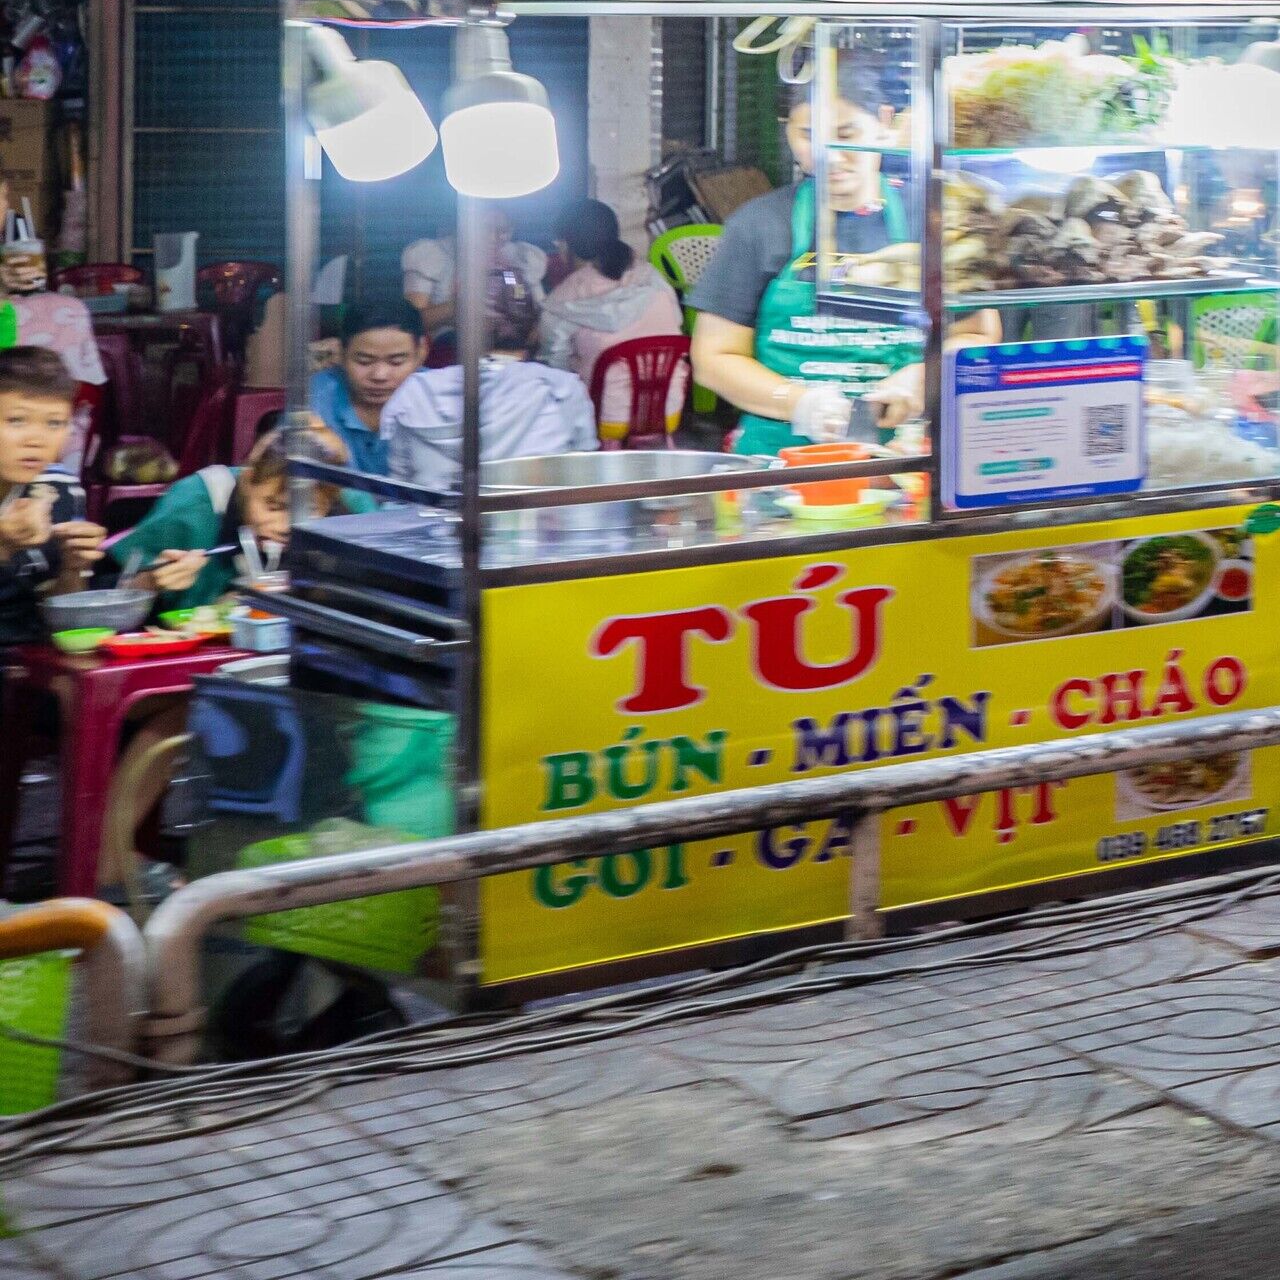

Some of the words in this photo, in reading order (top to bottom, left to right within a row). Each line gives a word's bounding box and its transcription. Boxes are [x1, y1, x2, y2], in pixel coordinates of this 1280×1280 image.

[593, 561, 895, 715] TÚ
[543, 725, 729, 812] BÚN
[791, 673, 992, 774] MIẾN
[1050, 648, 1248, 731] CHÁO
[936, 778, 1066, 844] VỊT
